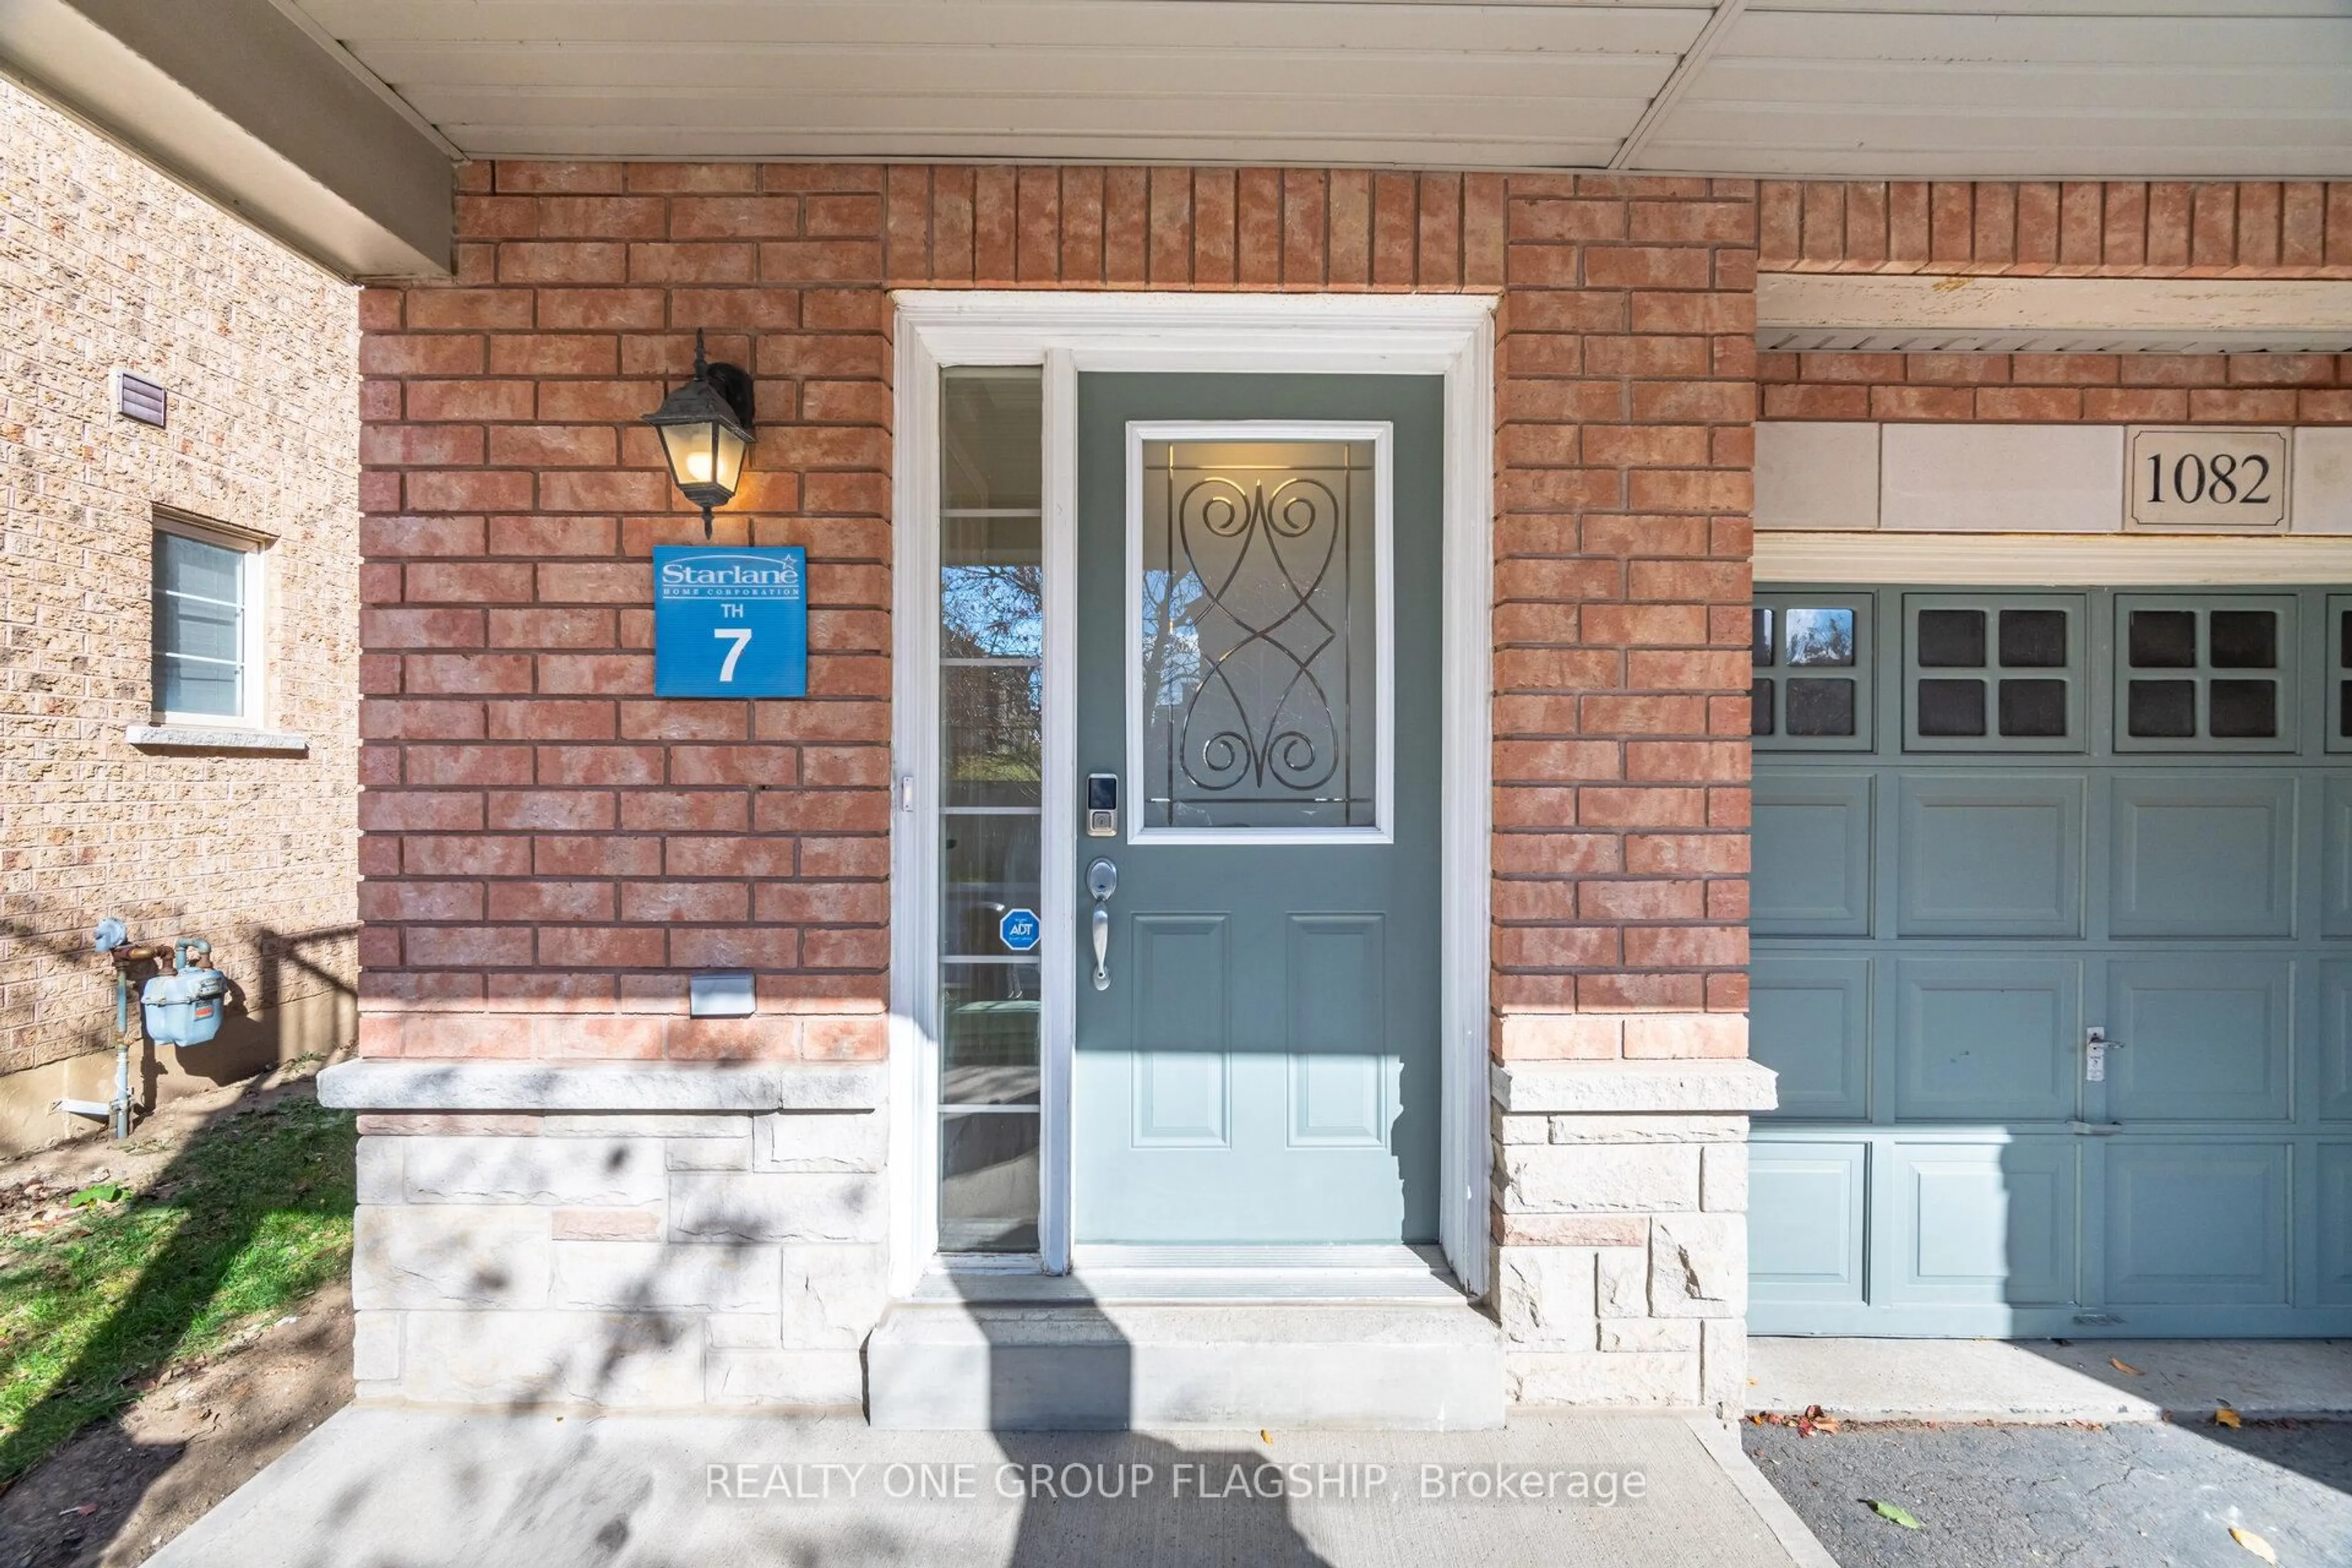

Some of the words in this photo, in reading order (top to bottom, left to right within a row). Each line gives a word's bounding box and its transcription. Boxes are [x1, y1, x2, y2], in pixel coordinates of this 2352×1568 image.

[2147, 453, 2271, 505] 1082
[662, 564, 799, 584] Starlane
[721, 604, 744, 618] TH
[714, 628, 752, 682] 7
[1009, 924, 1033, 936] ADT
